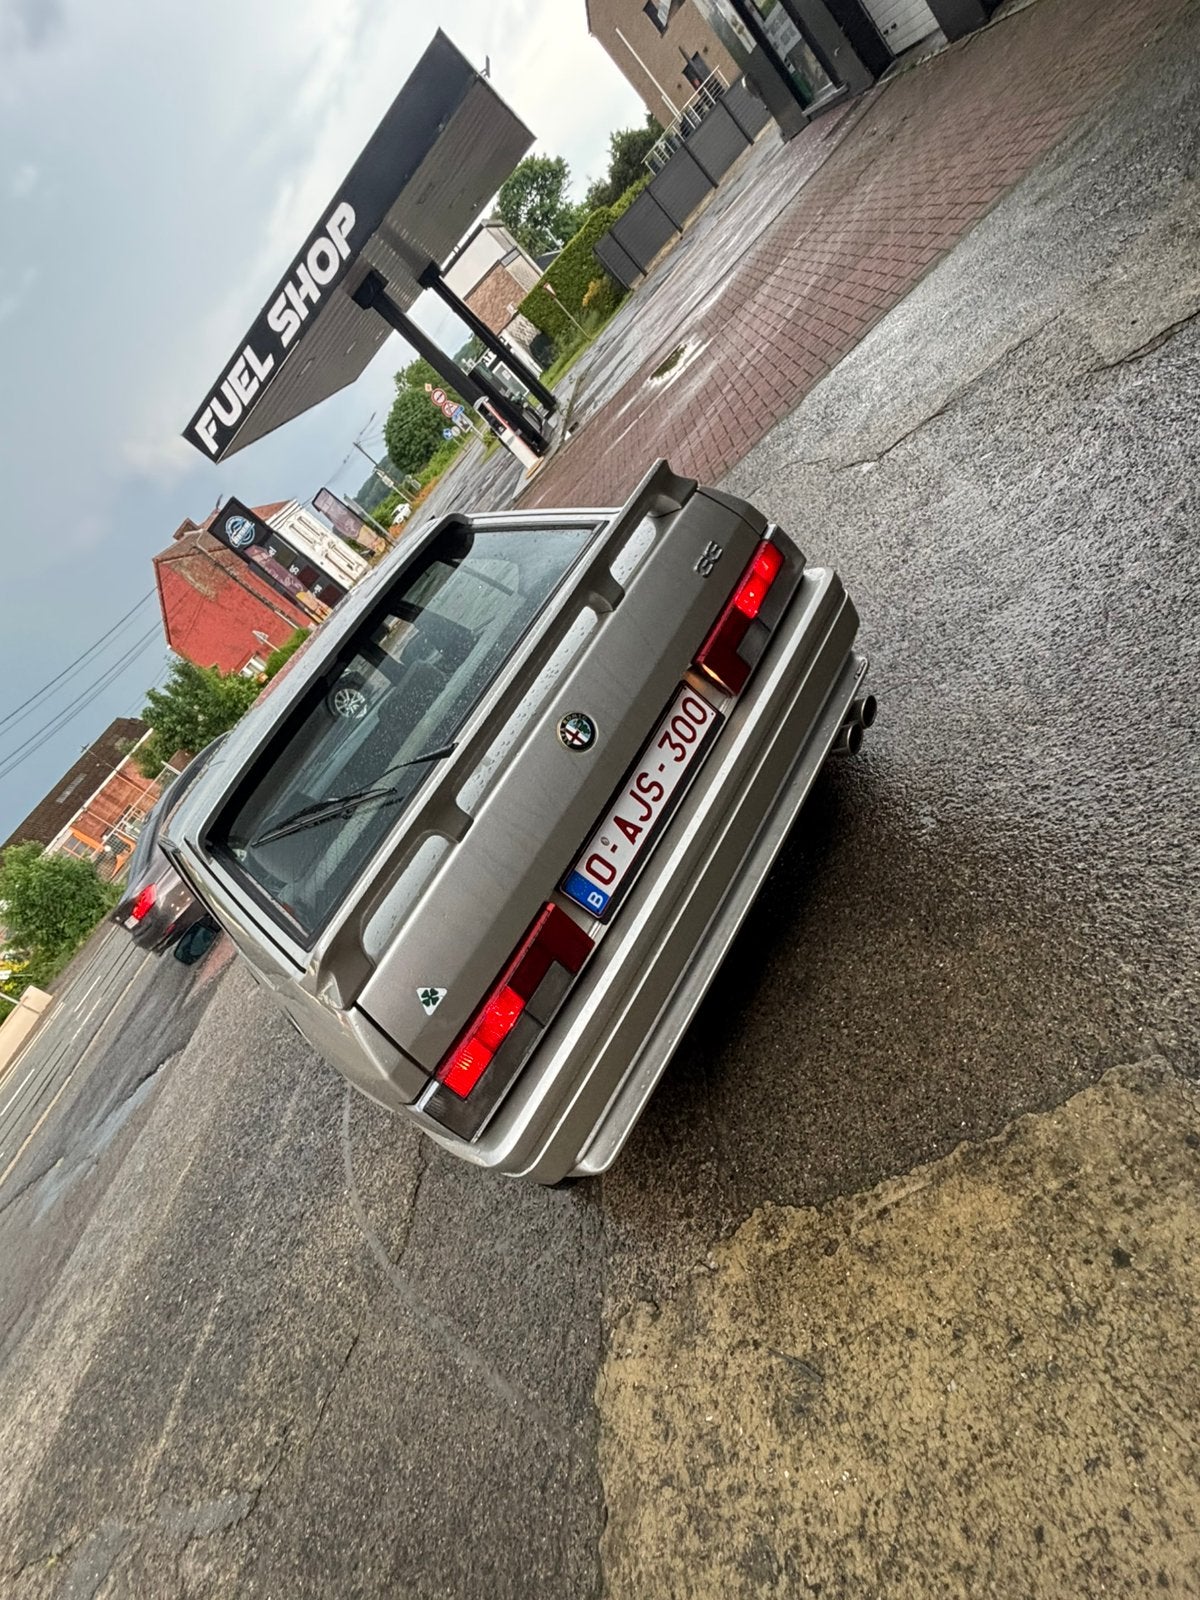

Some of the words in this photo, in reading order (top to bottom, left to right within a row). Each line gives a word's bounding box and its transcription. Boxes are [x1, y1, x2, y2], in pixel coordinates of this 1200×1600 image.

[194, 344, 275, 455] FUEL
[266, 201, 356, 348] SHOP
[586, 891, 604, 908] B
